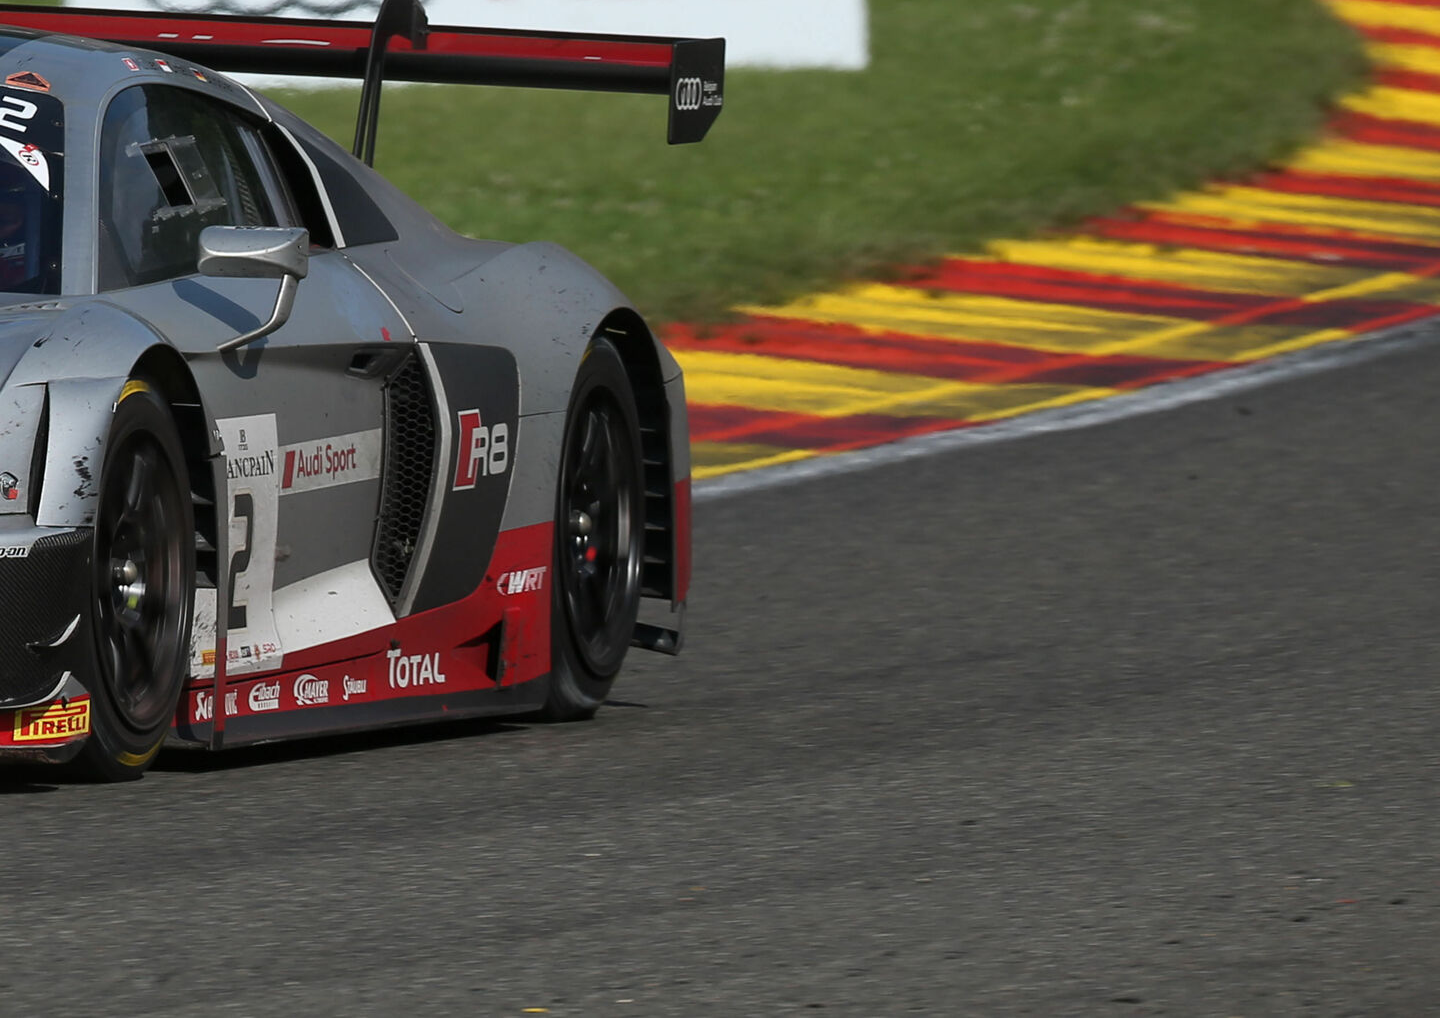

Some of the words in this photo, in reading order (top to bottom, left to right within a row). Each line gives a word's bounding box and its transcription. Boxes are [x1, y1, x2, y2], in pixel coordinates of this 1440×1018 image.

[227, 449, 274, 479] ANCPAIN
[296, 445, 322, 479] Audi
[325, 443, 357, 480] Sport
[464, 419, 509, 482] R8
[226, 493, 254, 630] 2
[506, 565, 548, 595] WRT
[386, 648, 446, 689] TOTAL
[248, 680, 281, 711] Eibach
[20, 703, 88, 737] PIRELLI
